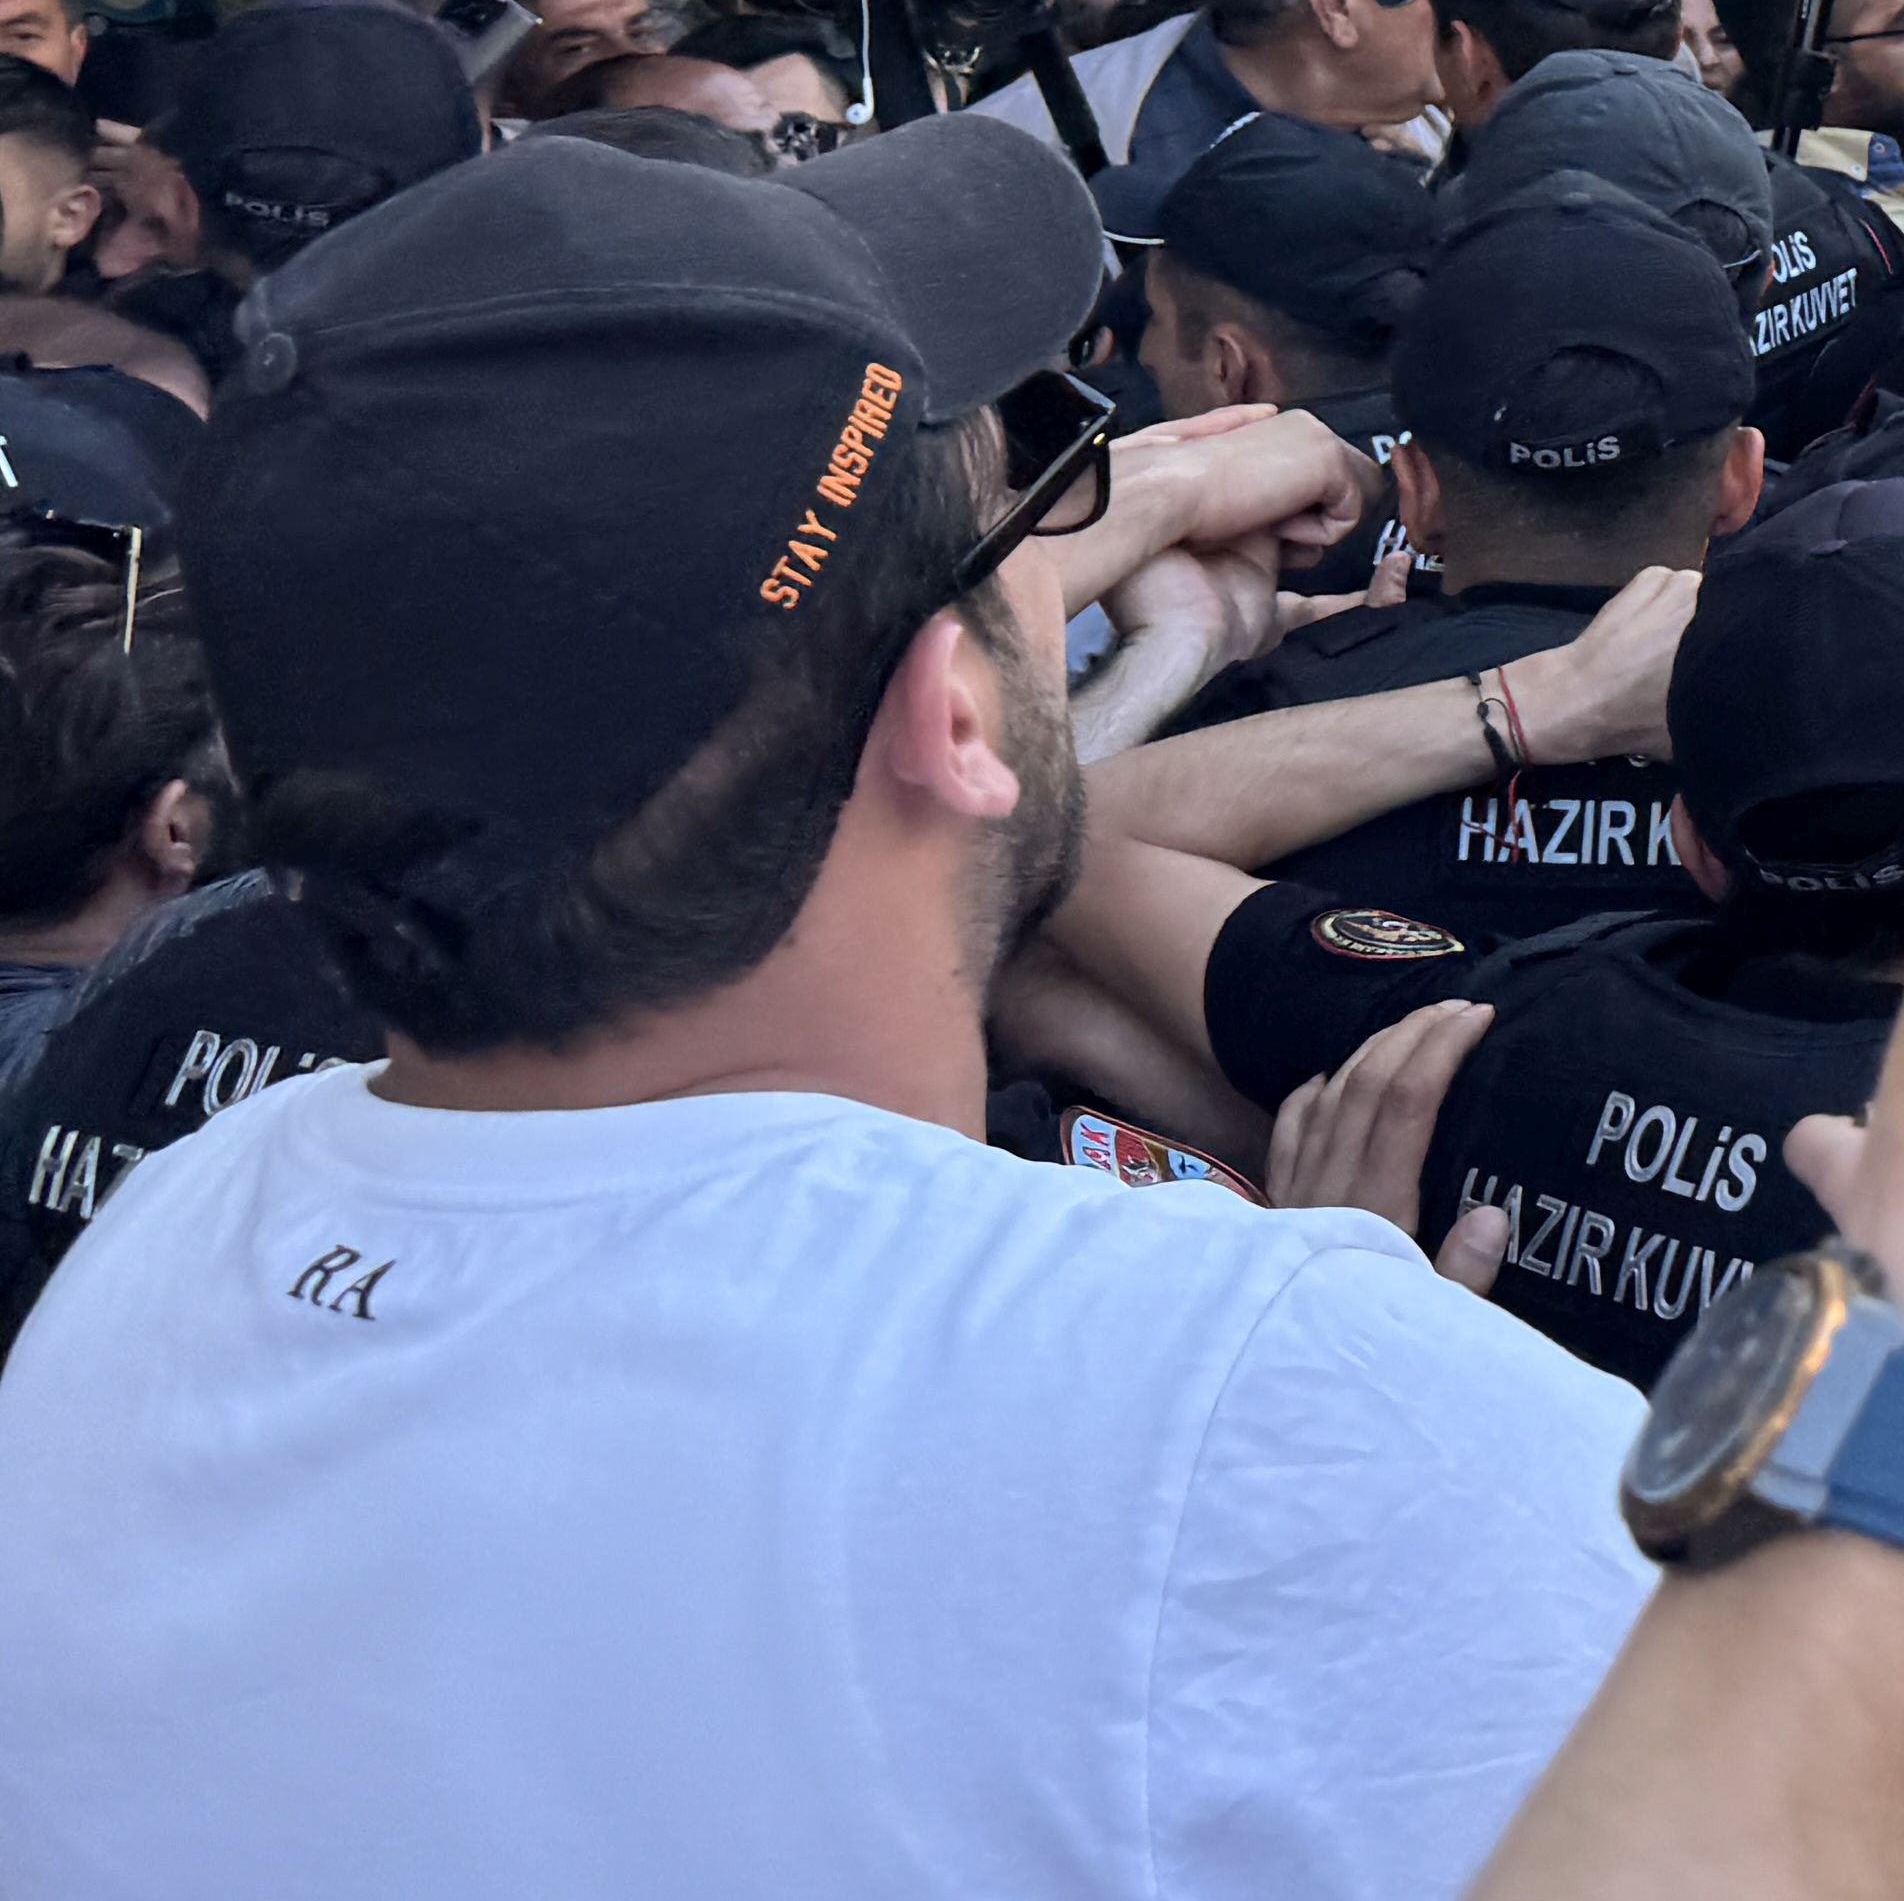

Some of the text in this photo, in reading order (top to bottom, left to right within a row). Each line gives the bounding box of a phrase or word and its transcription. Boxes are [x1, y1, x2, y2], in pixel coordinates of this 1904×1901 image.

[759, 362, 903, 611] STAY INSPIRED
[1458, 797, 1633, 866] HAZIR
[287, 1243, 398, 1322] RA
